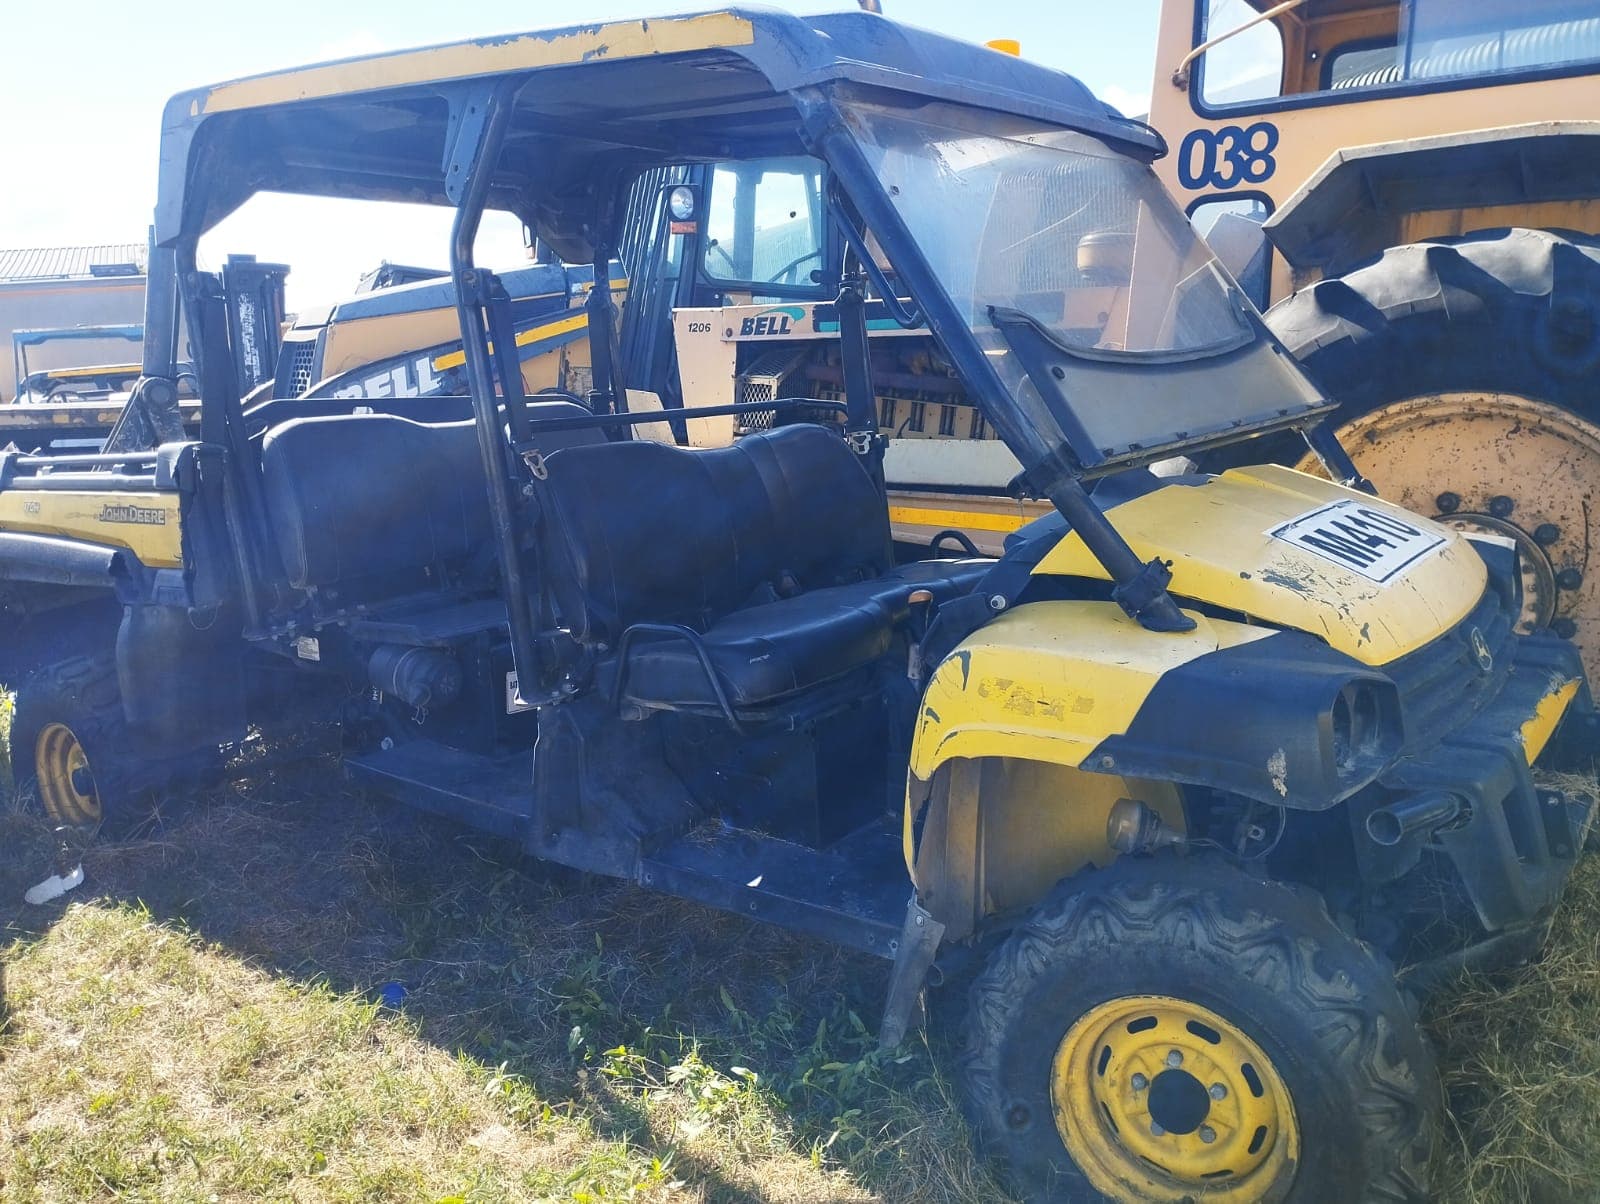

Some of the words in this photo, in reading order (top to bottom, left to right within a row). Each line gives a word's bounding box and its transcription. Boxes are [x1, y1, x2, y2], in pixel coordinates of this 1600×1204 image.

[1178, 121, 1279, 190] 038
[687, 322, 711, 333] 1206
[740, 316, 792, 336] BELL
[99, 503, 128, 522] JOHN
[129, 501, 165, 524] DEERE
[1299, 508, 1422, 569] M410
